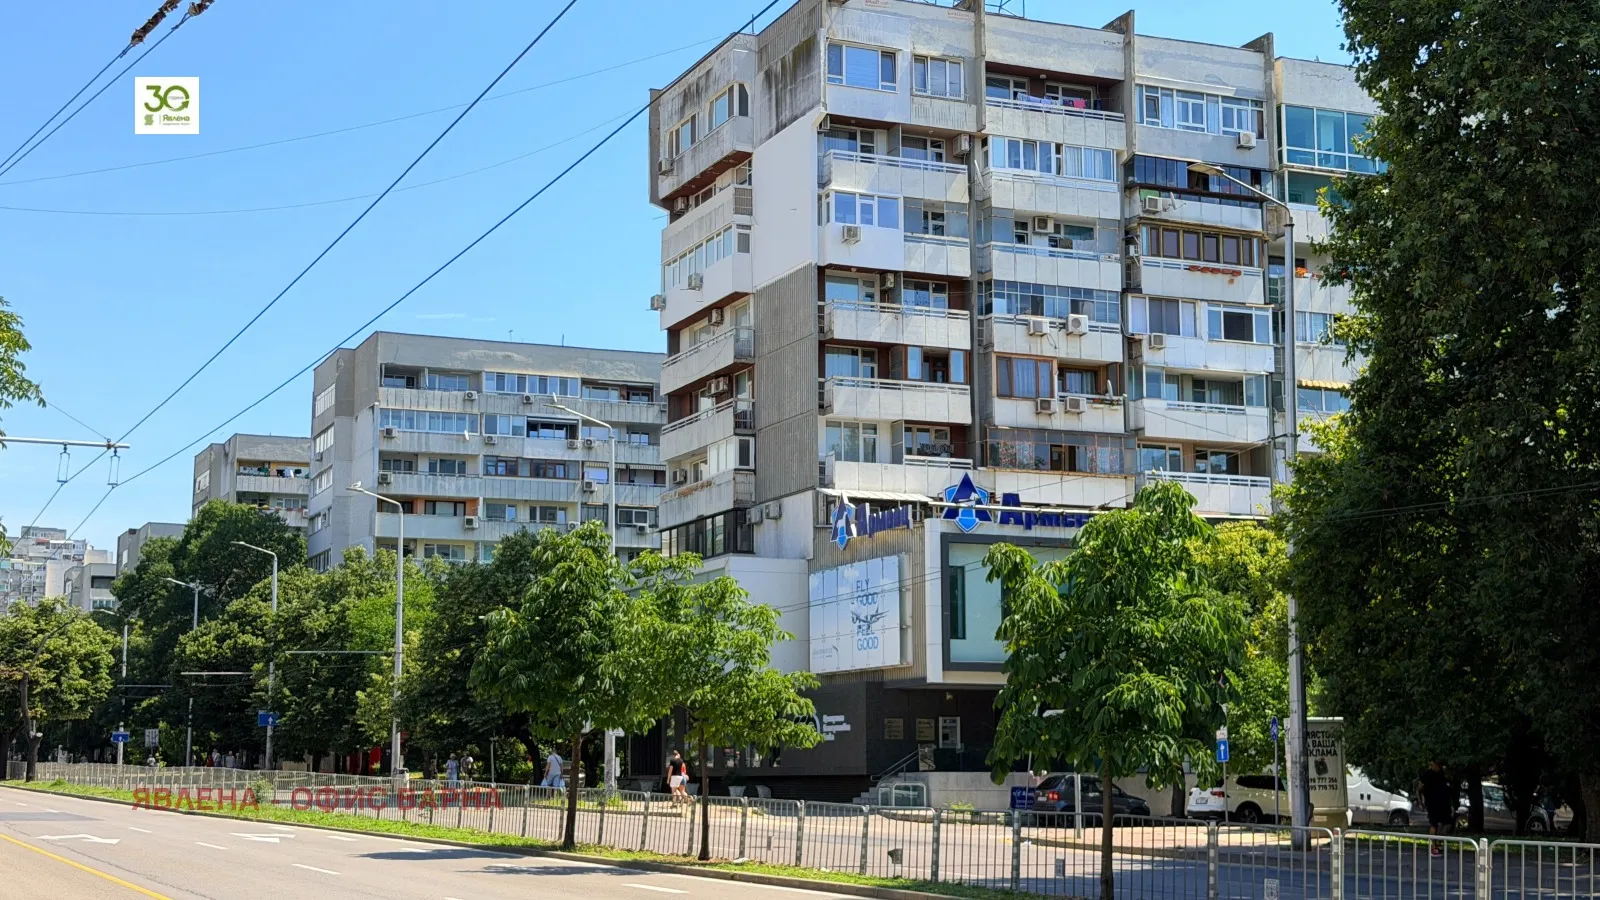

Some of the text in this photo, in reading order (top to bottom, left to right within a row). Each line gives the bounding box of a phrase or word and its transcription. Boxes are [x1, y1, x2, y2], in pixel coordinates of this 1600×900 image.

[856, 579, 870, 592] FLY
[857, 637, 879, 651] GOOD
[1309, 749, 1338, 757] КЛАМА
